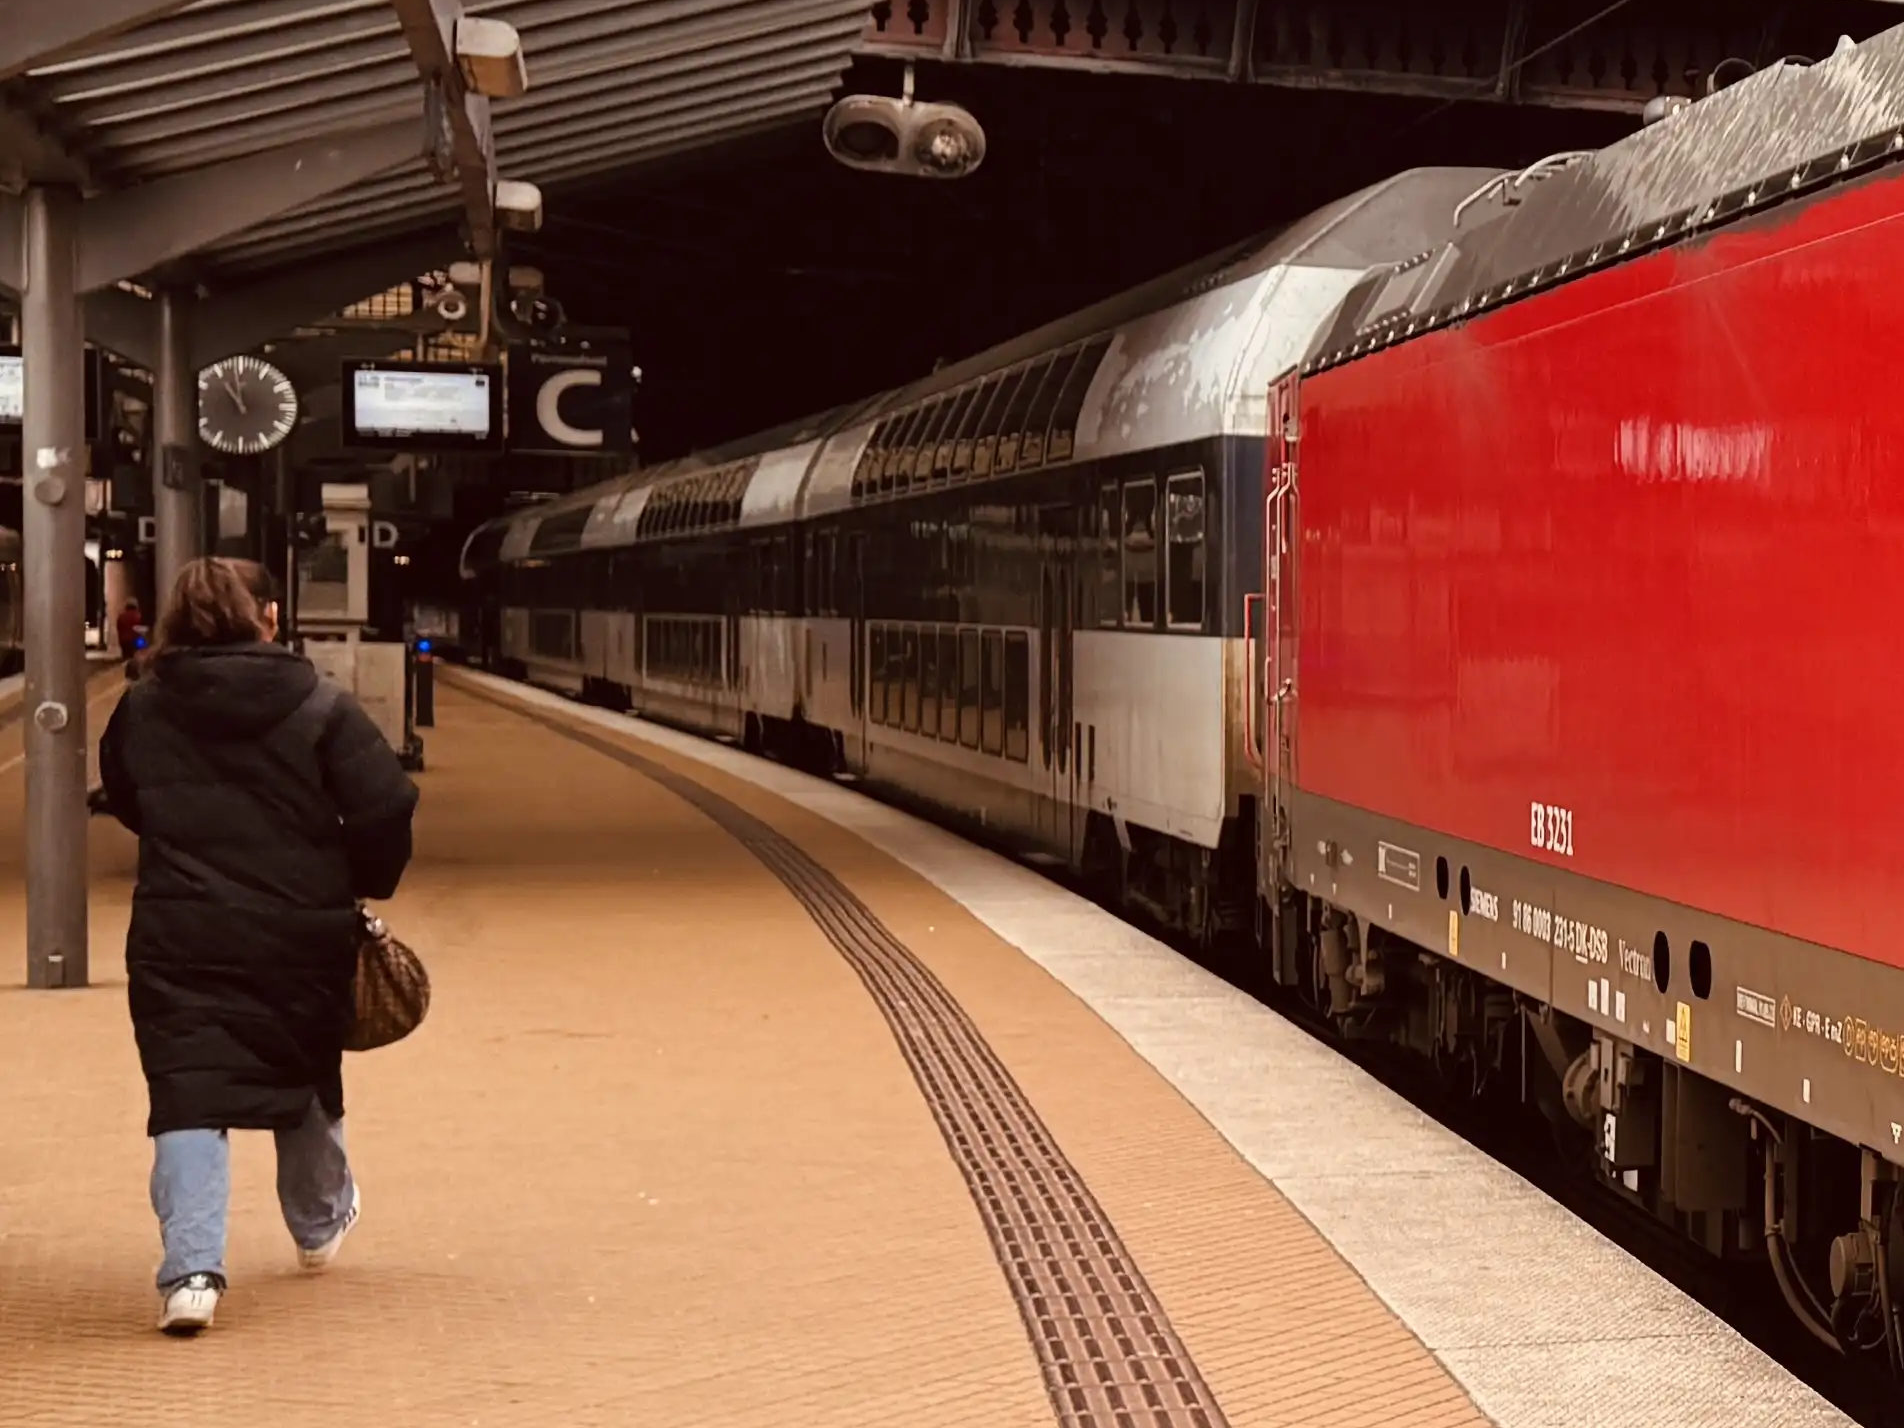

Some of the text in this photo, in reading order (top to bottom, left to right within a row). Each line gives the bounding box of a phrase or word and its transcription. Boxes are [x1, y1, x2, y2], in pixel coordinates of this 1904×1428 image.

[536, 369, 604, 446] C
[1531, 801, 1574, 857] EB 3231
[1469, 885, 1499, 922] SIEMENS
[1618, 937, 1651, 982] Vectron
